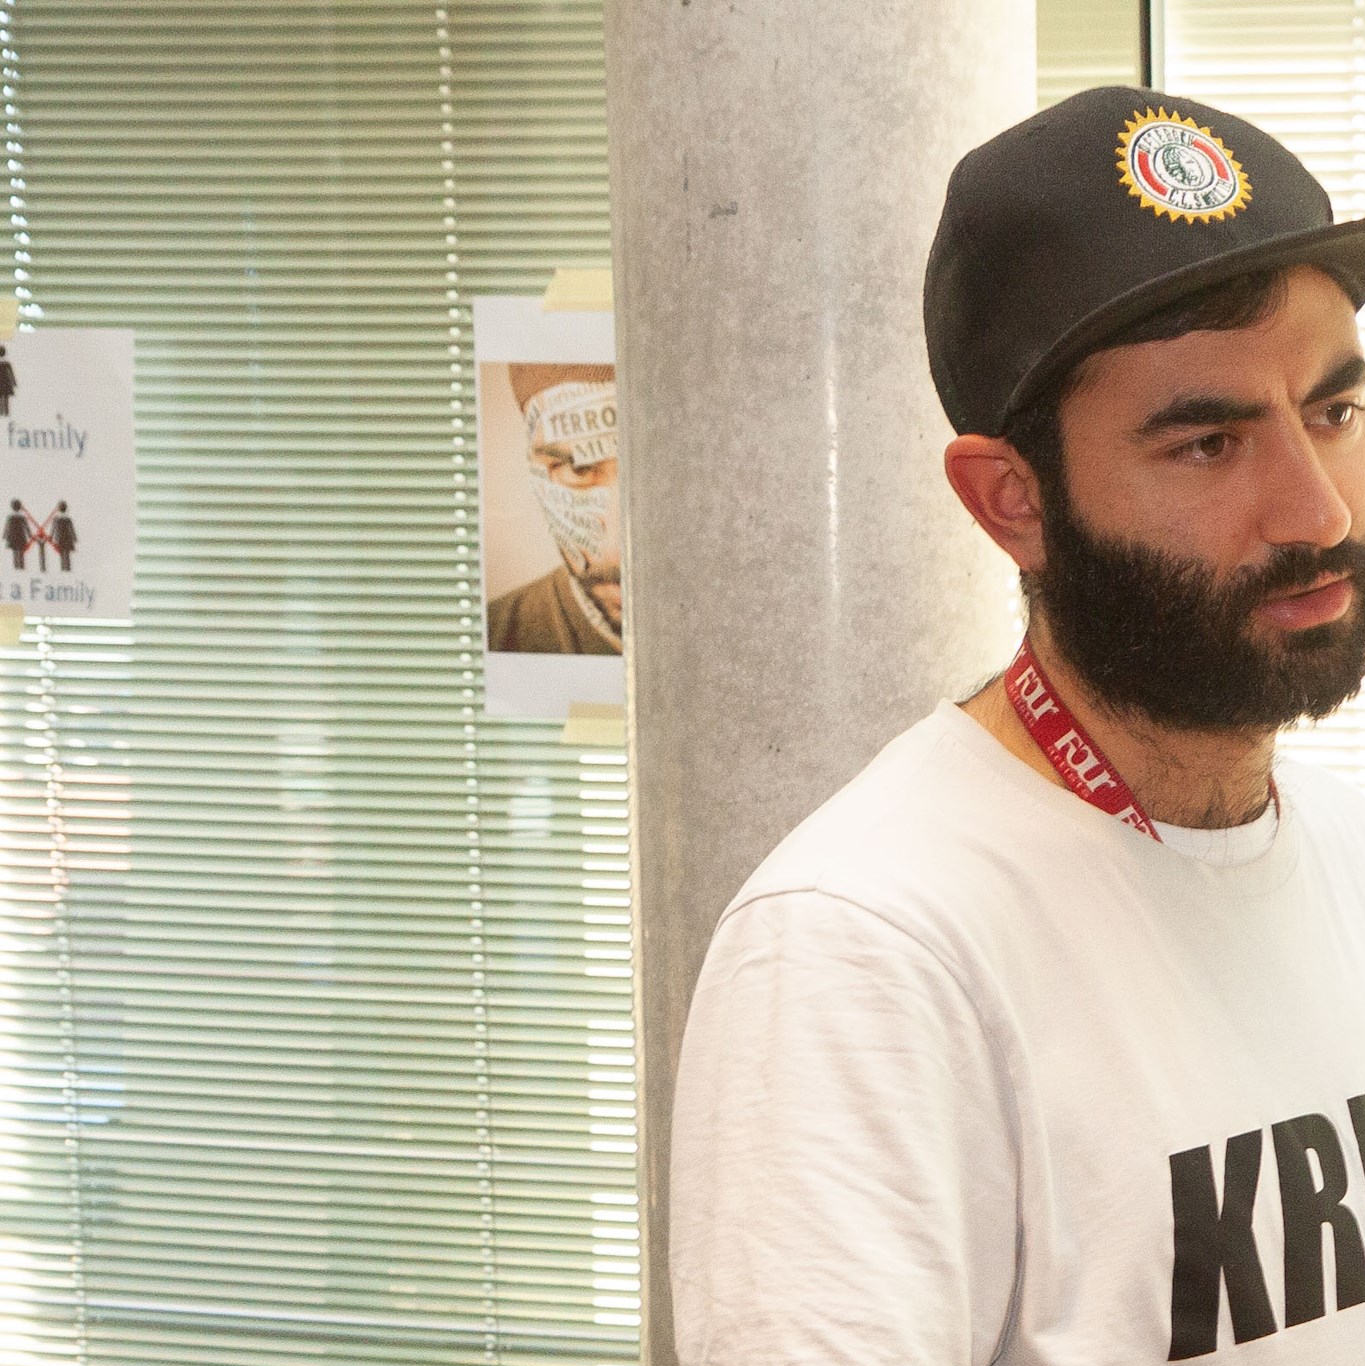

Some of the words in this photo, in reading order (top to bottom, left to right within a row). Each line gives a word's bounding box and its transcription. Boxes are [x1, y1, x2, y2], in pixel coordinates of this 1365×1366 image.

[7, 413, 88, 459] family
[9, 582, 22, 601] a
[28, 577, 97, 609] Family
[1053, 728, 1117, 793] Four
